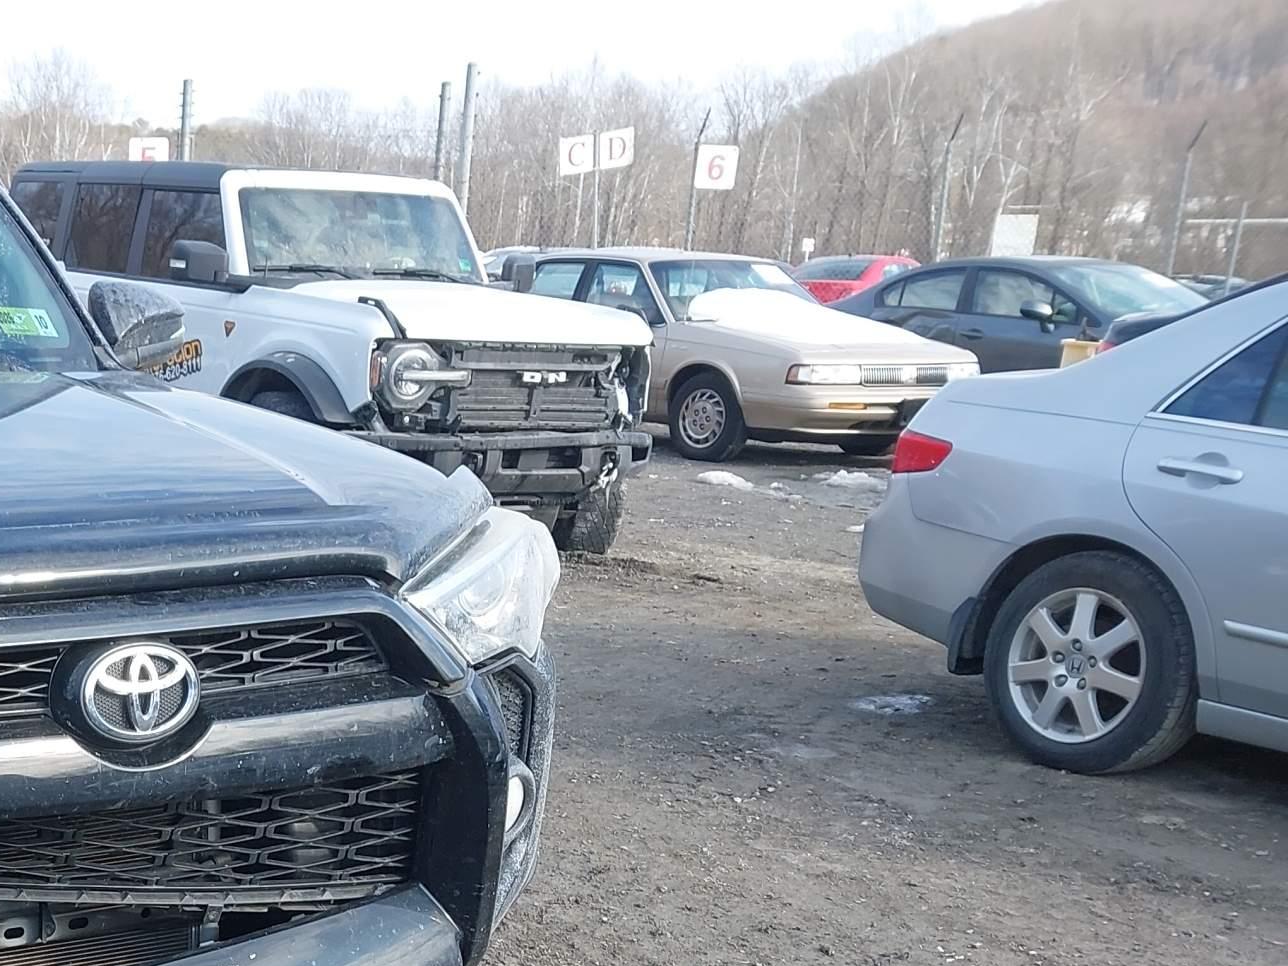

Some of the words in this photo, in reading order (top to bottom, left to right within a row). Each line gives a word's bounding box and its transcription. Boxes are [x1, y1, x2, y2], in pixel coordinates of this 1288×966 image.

[568, 142, 585, 167] C
[608, 136, 626, 161] D
[708, 155, 725, 180] 6
[34, 314, 48, 330] 10
